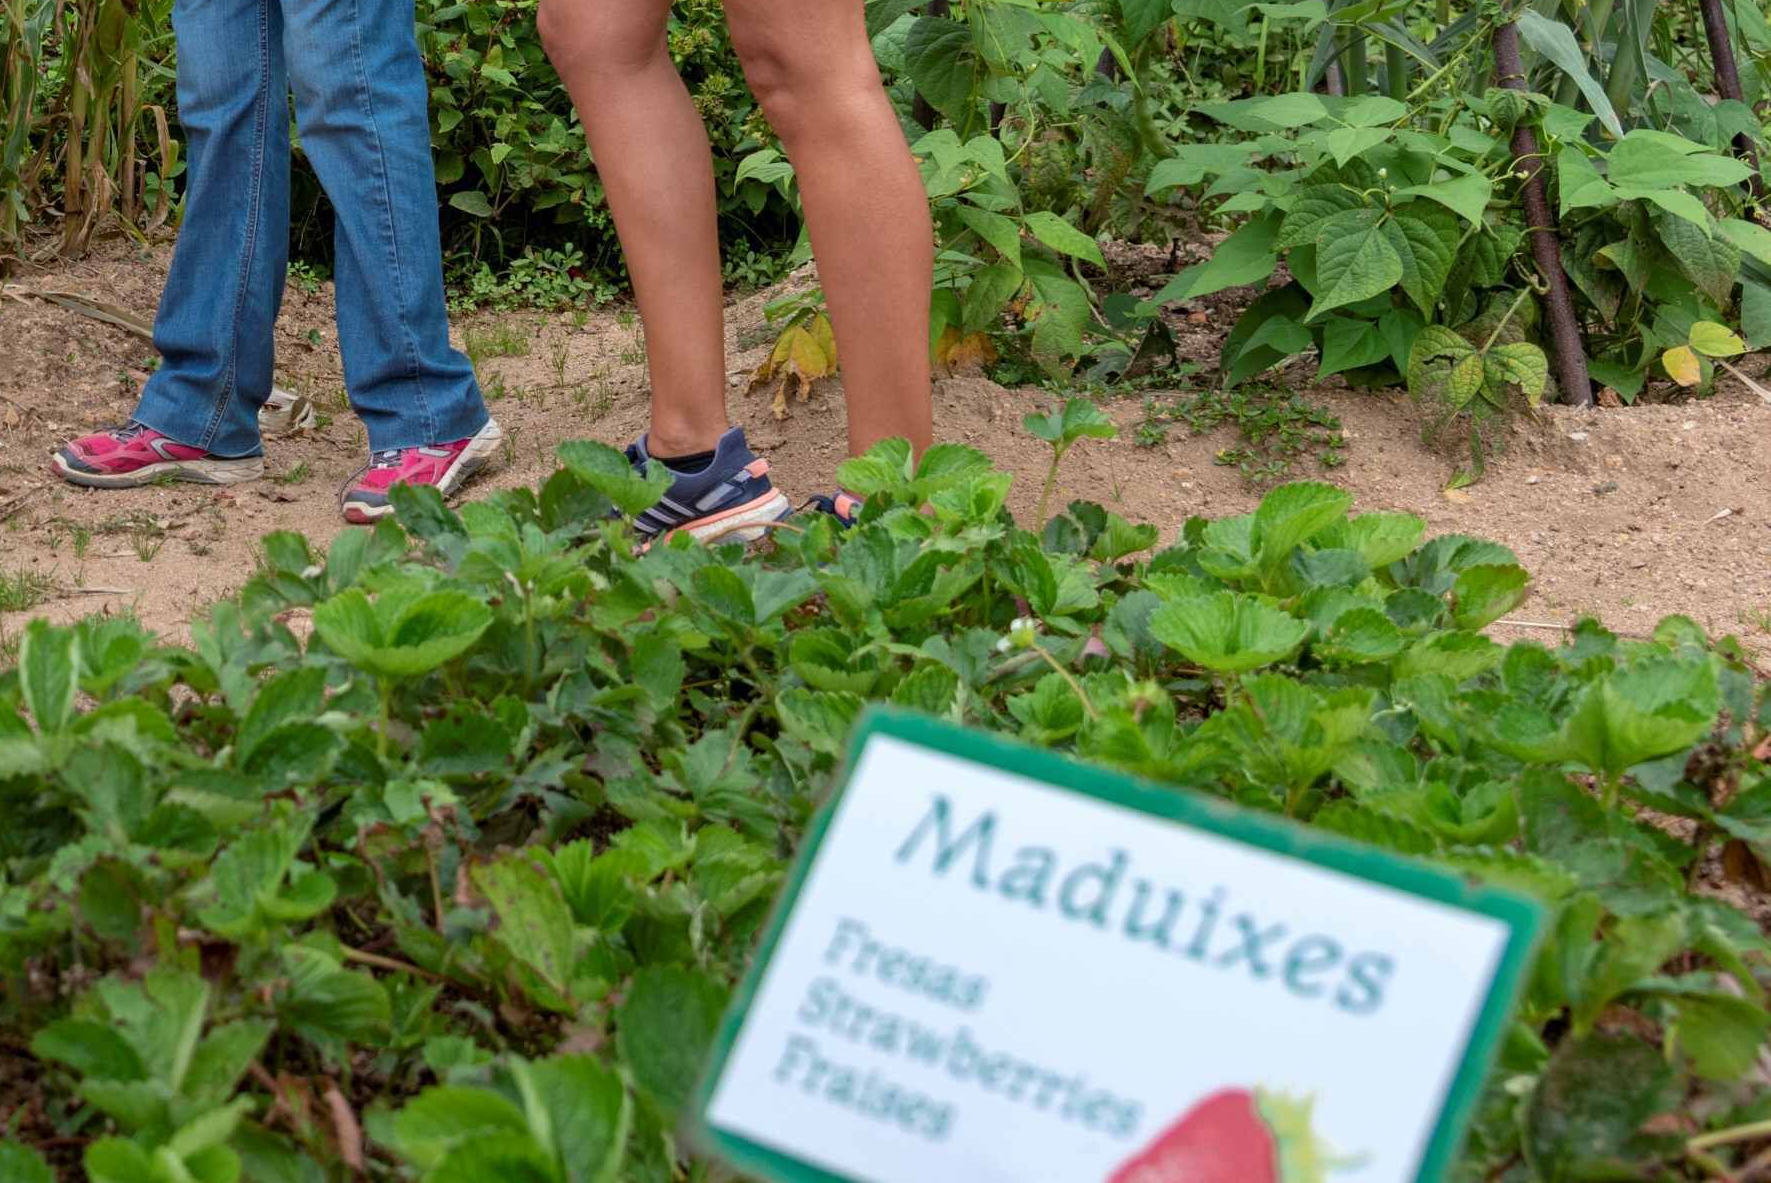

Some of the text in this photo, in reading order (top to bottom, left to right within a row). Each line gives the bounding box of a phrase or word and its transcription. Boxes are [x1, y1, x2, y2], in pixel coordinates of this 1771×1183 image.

[824, 918, 988, 1013] Fresas
[892, 792, 1396, 1017] Maduixes
[773, 1033, 957, 1141] Fraises
[797, 975, 1143, 1138] Strawberries
